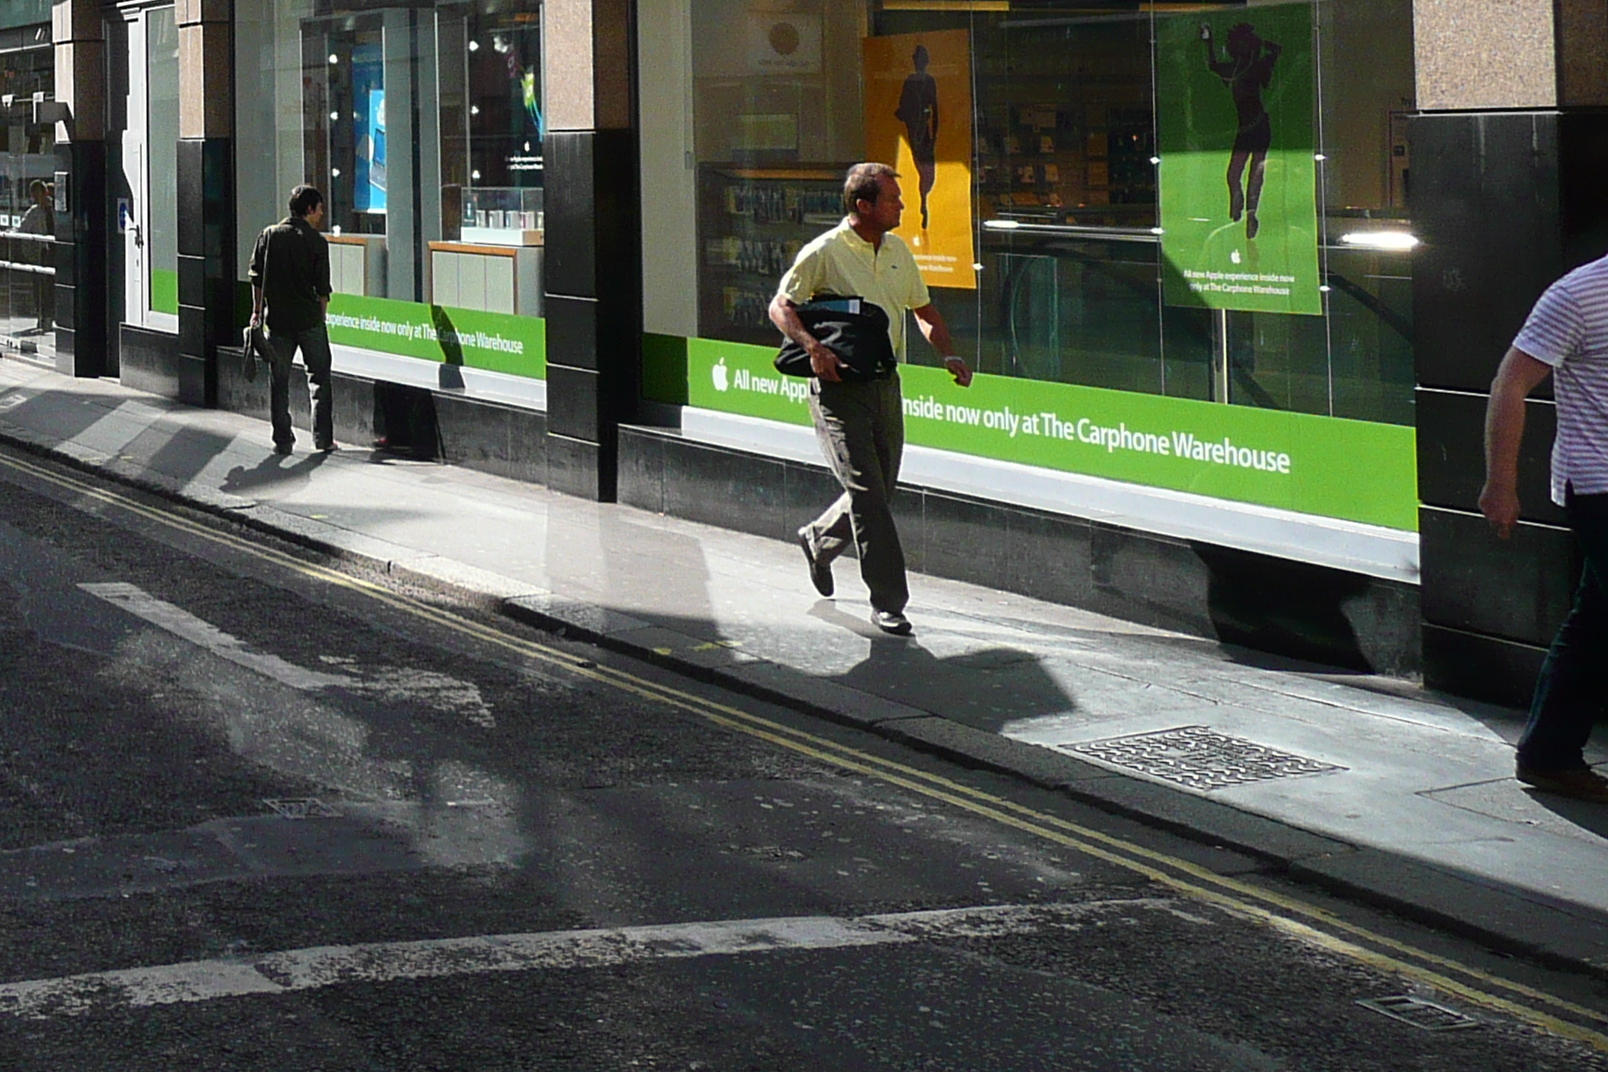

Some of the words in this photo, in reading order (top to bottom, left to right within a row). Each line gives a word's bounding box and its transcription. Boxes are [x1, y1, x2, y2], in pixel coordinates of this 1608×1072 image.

[359, 313, 381, 332] inside
[381, 321, 397, 334] now
[397, 321, 413, 341] only
[413, 325, 422, 338] at
[422, 323, 436, 341] The
[476, 331, 523, 355] Warehouse
[733, 369, 750, 390] All
[751, 377, 778, 395] new
[903, 395, 943, 421] nside
[946, 406, 981, 426] now
[983, 406, 1019, 438] only
[1022, 415, 1040, 435] at
[1040, 412, 1075, 440] The
[1077, 417, 1170, 456] Carphone
[1172, 431, 1291, 474] Warehouse
